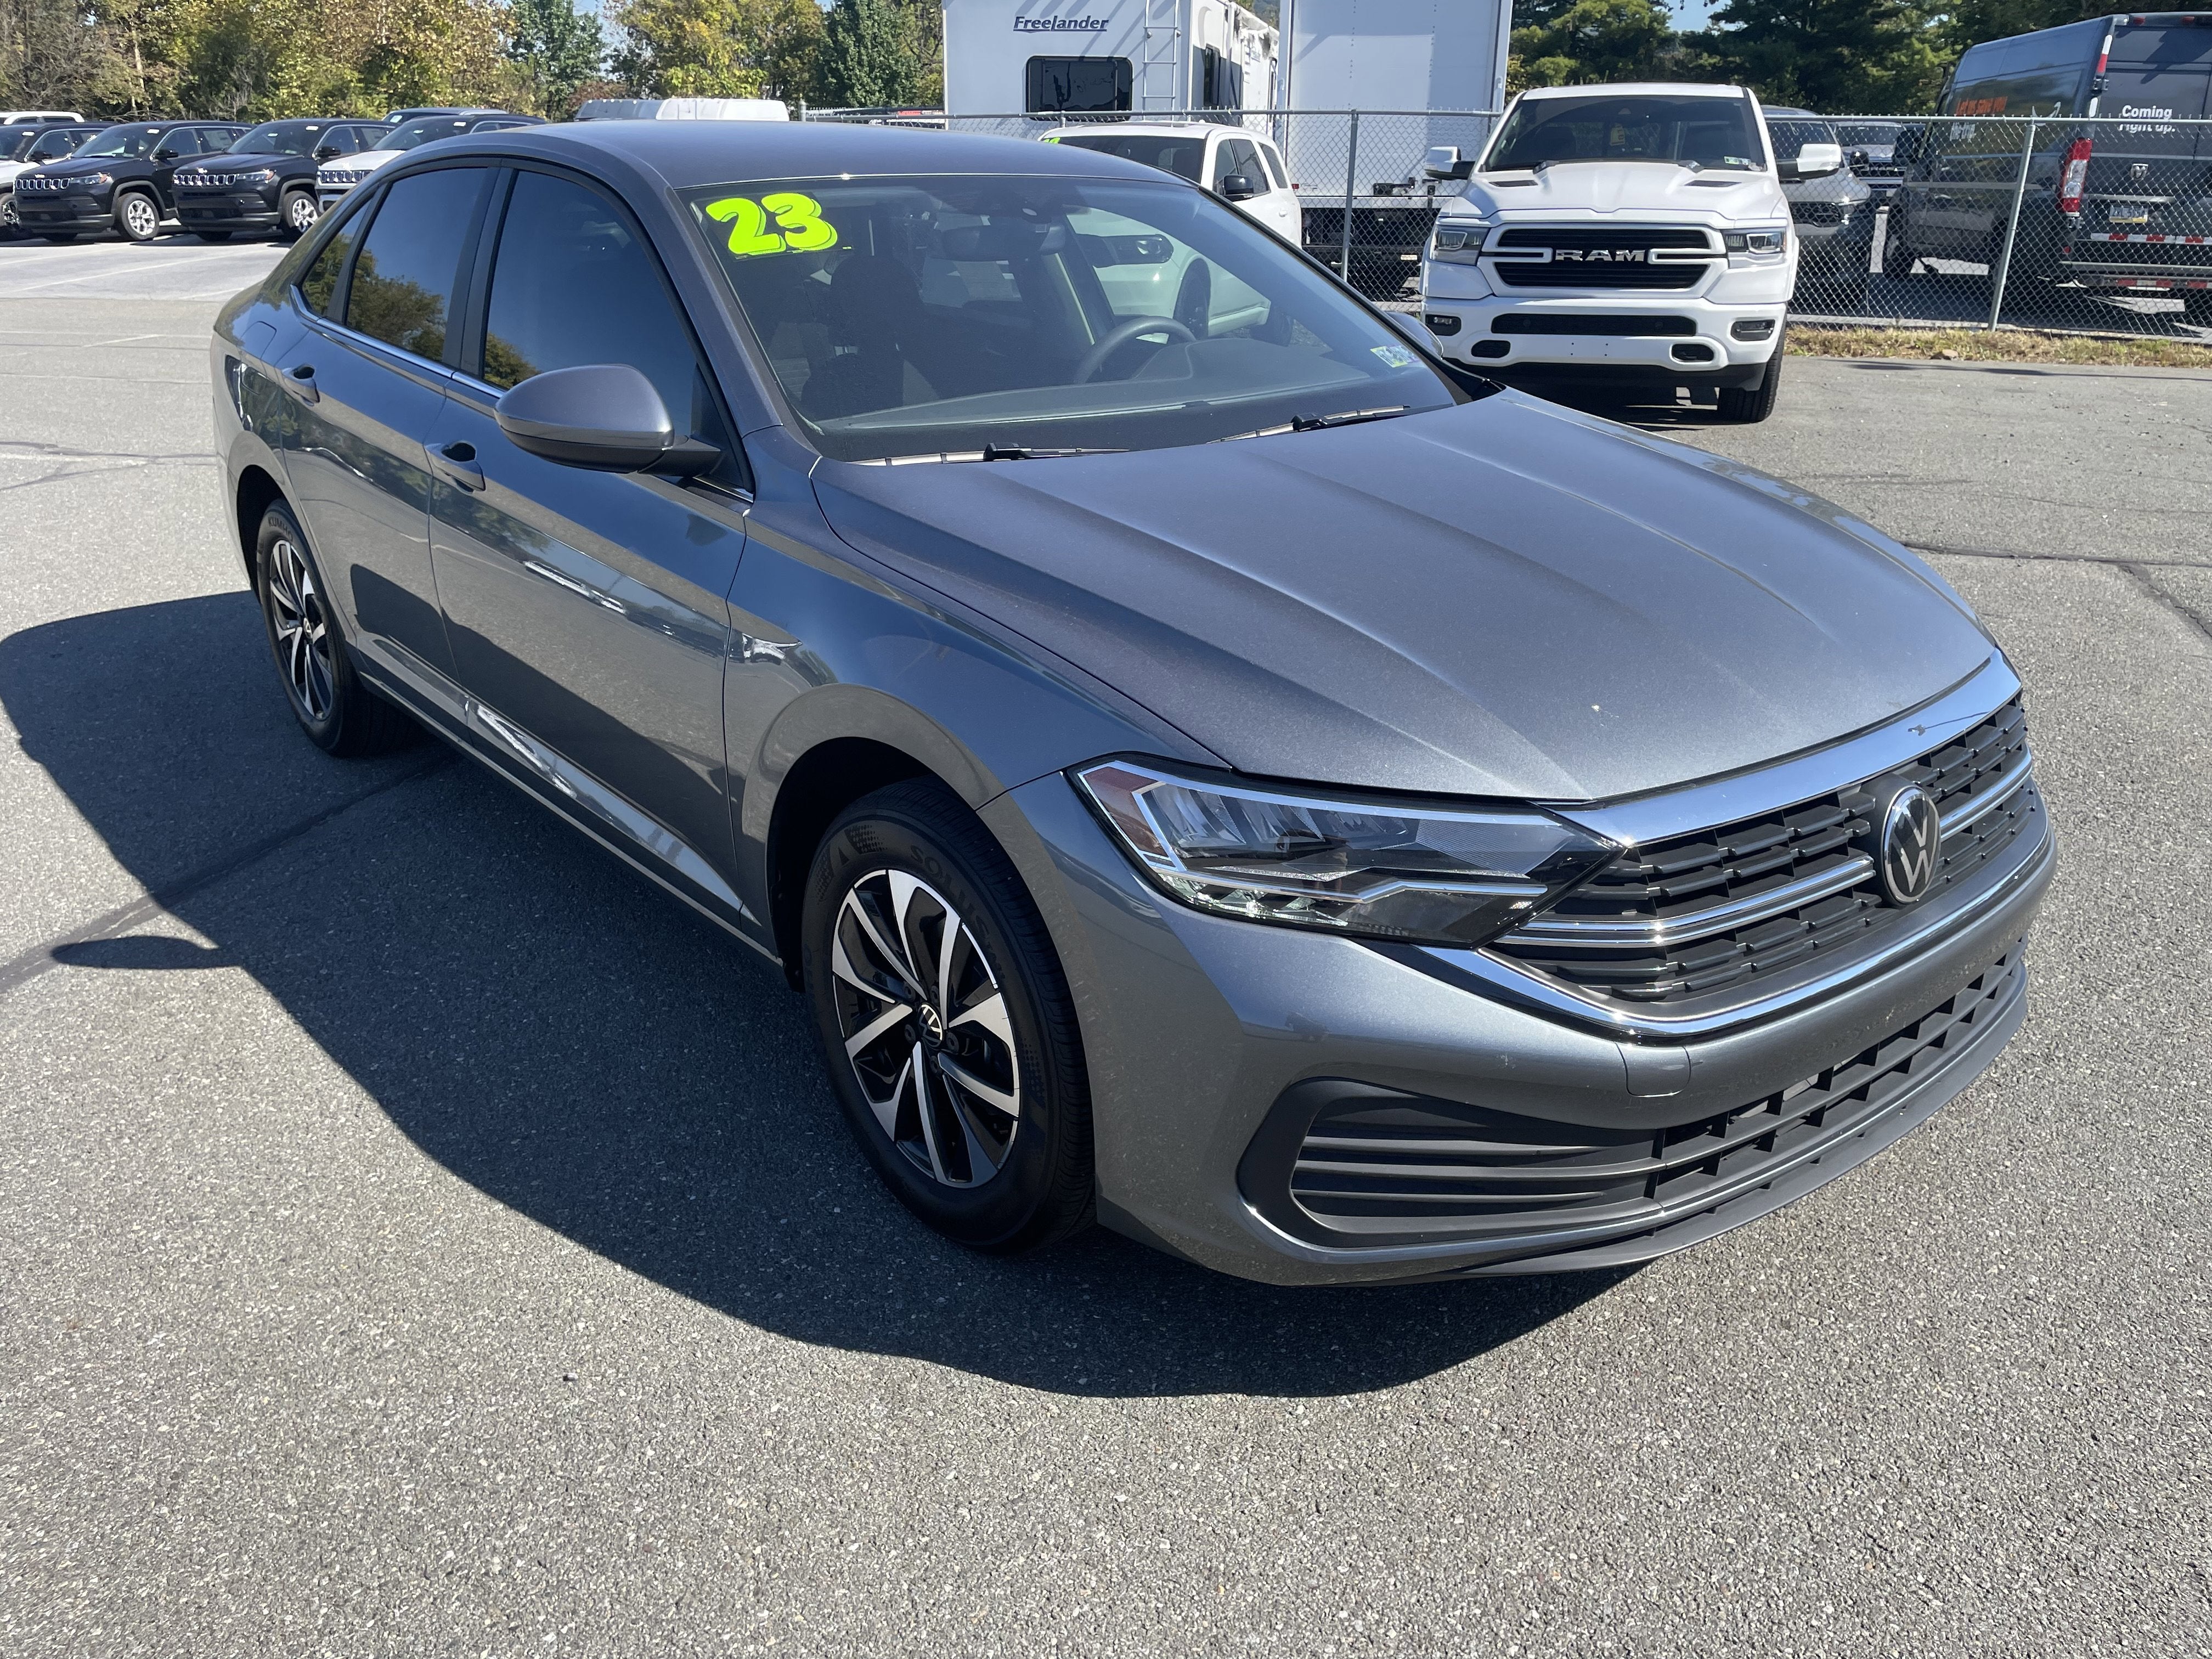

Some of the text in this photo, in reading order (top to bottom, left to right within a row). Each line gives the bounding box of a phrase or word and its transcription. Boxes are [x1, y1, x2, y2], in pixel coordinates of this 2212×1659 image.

[1013, 15, 1109, 31] Freelander
[2122, 105, 2172, 120] Coming
[706, 193, 838, 255] 23
[1555, 250, 1646, 261] RAM
